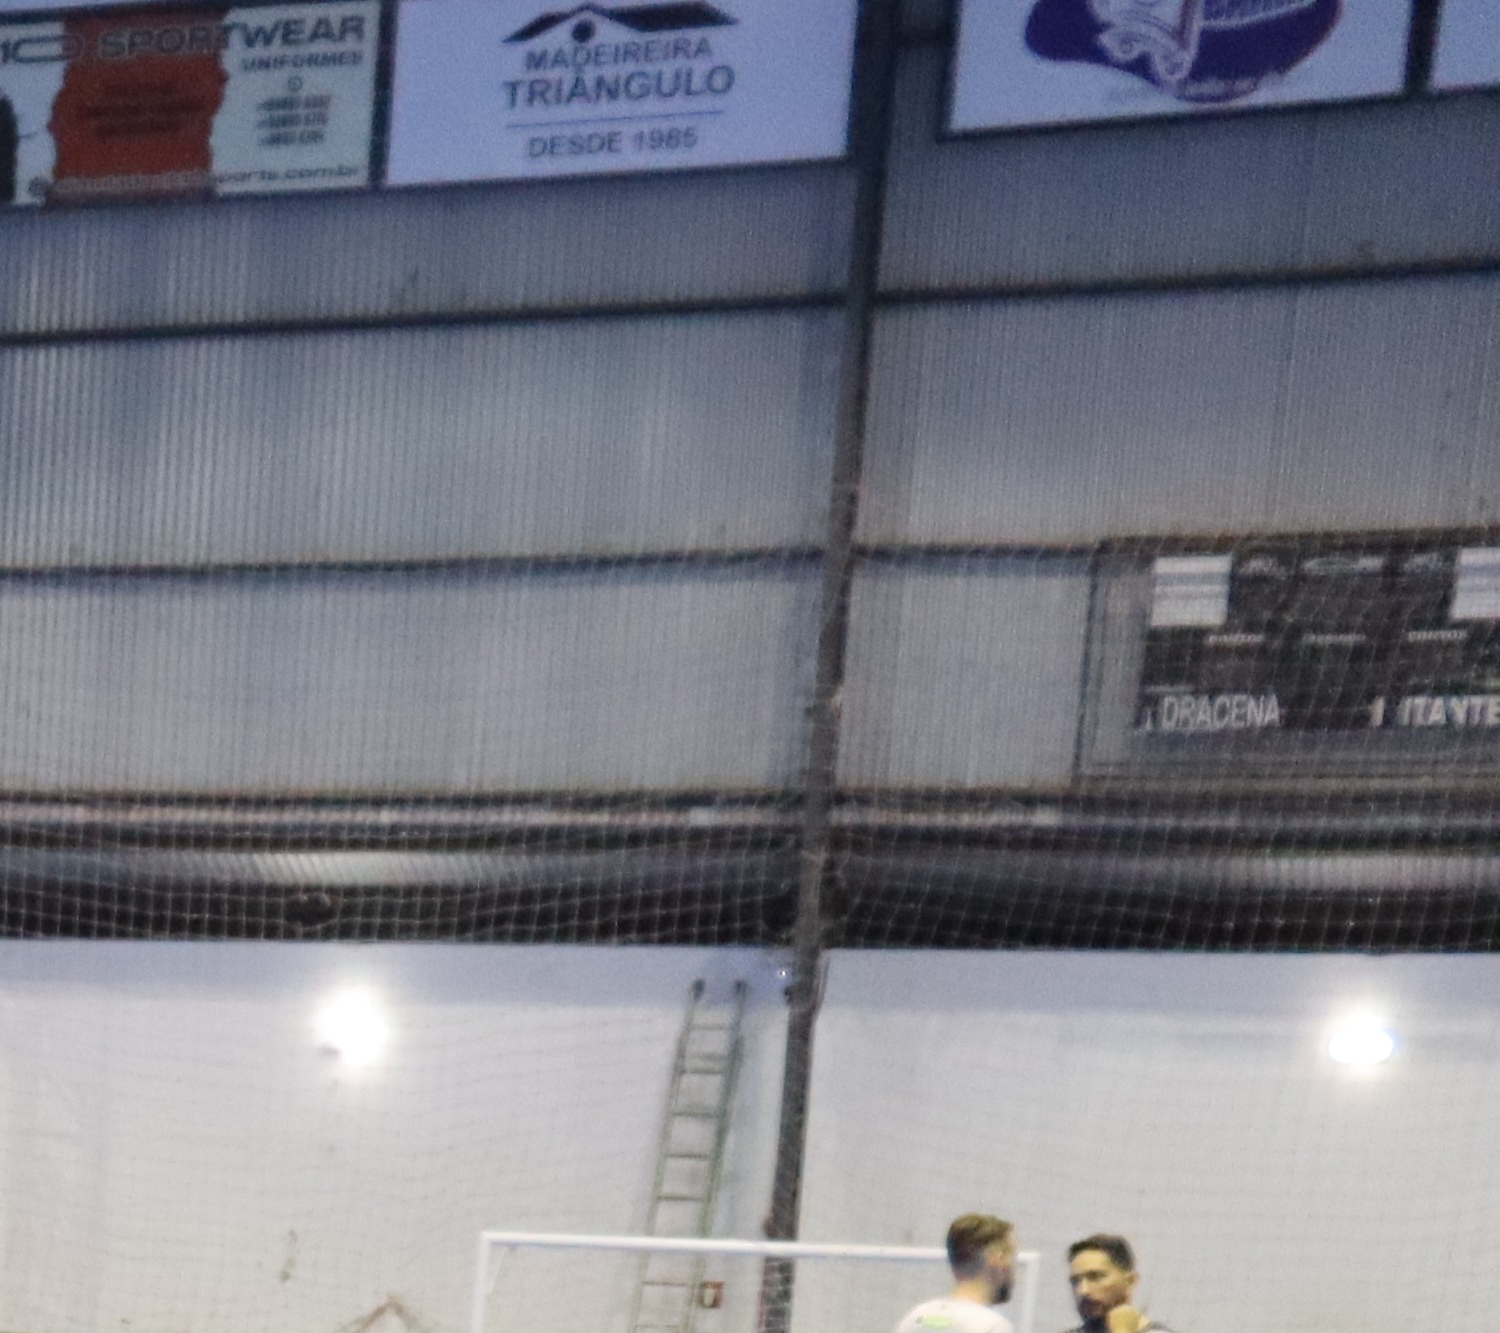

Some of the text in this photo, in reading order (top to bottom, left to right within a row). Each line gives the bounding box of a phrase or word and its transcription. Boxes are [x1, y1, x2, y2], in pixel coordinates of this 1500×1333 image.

[524, 37, 713, 70] MADEIREIRA
[528, 131, 622, 157] DESDE
[1162, 693, 1281, 732] DRACENA
